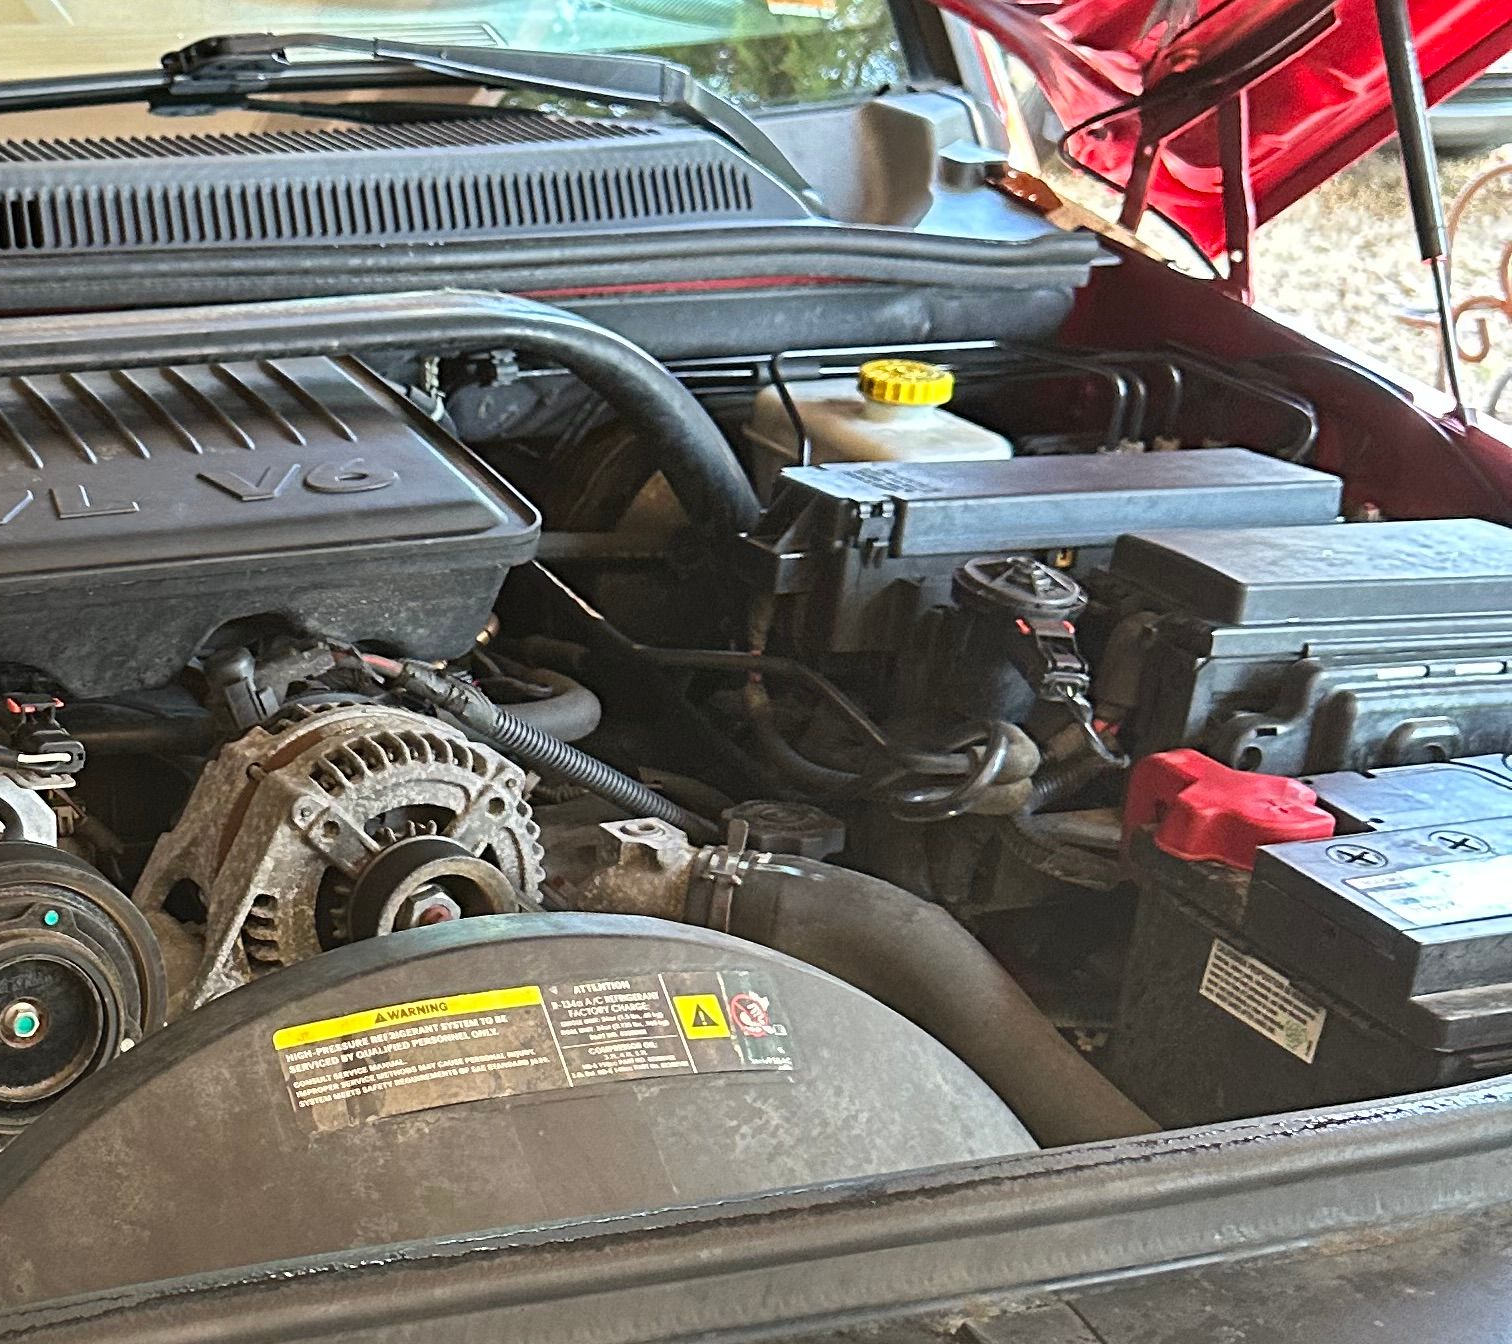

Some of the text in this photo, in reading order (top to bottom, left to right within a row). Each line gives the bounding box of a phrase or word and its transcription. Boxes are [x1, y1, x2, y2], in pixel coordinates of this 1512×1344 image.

[195, 457, 400, 502] V6
[573, 981, 630, 994] ATTENTION
[387, 1002, 449, 1021] WARNING
[285, 1037, 370, 1062] HIGH-PRESSURE
[370, 1022, 439, 1044] REFRIGERANT
[480, 1016, 494, 1026] TO
[289, 1057, 340, 1074] SERVICED
[341, 1053, 354, 1063] BY
